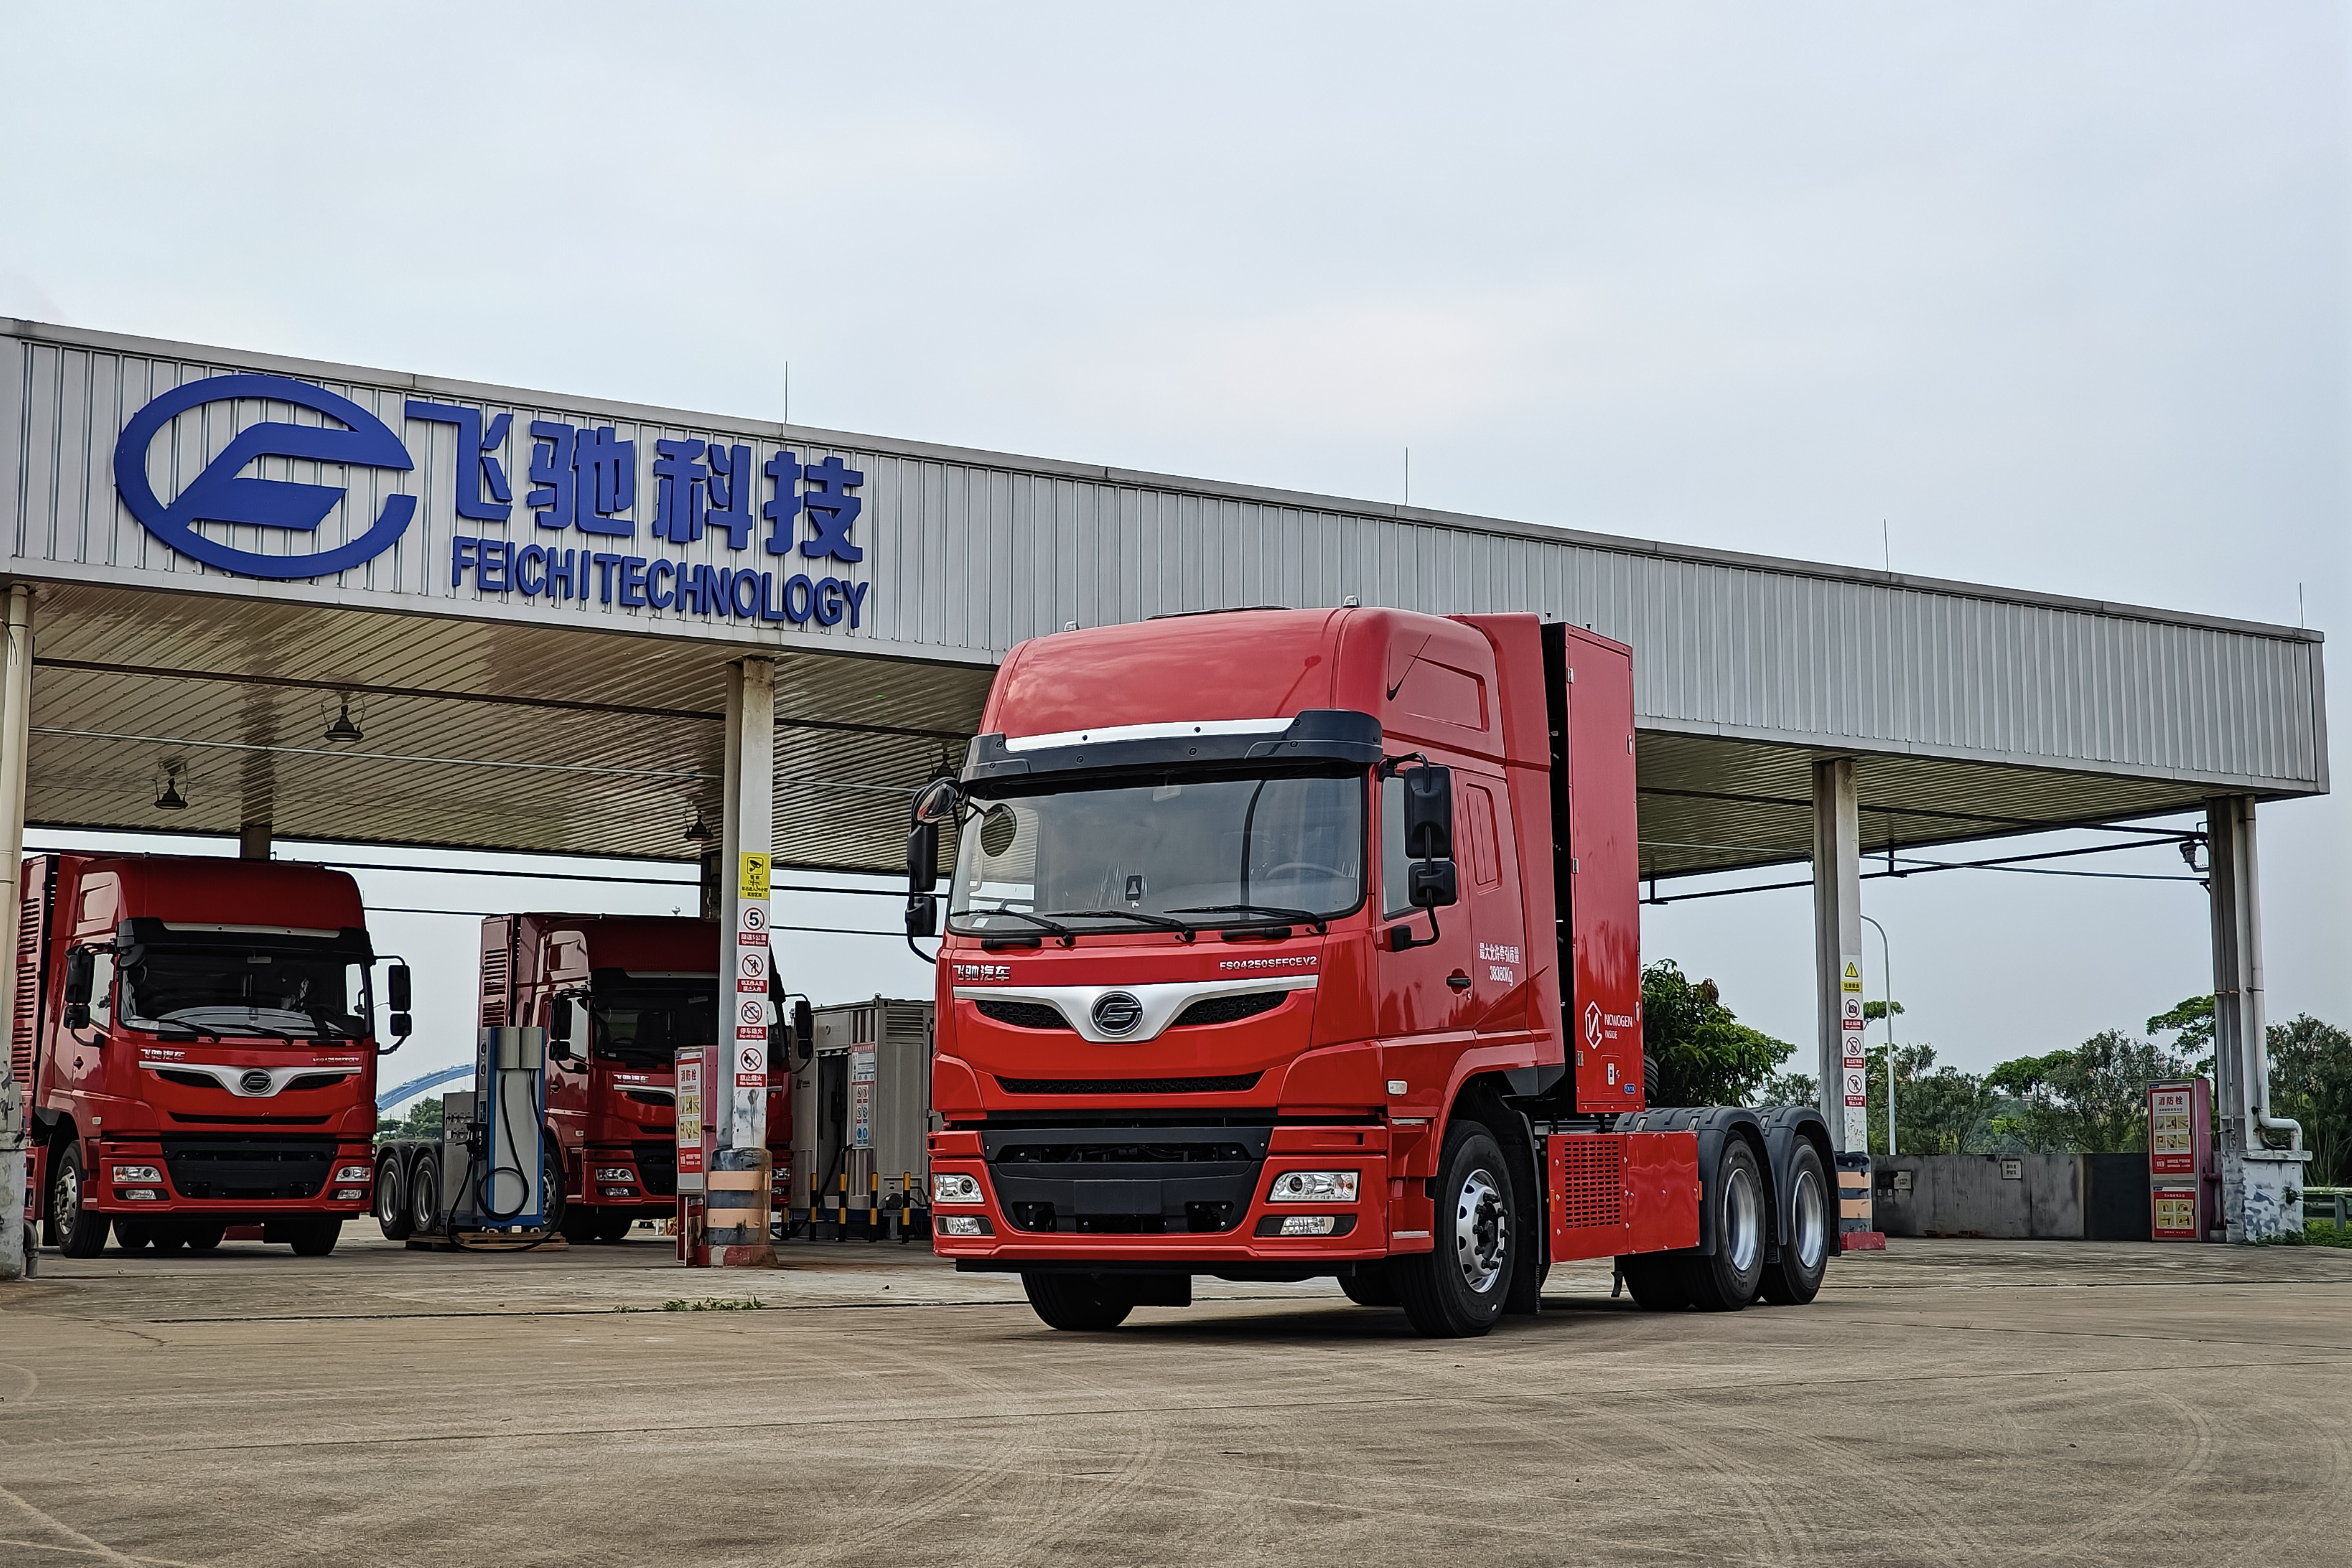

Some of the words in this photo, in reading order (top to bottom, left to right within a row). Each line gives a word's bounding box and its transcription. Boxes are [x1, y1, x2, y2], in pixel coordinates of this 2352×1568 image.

[405, 400, 863, 562] 飞驰科技
[749, 912, 759, 926] 5
[1479, 942, 1520, 964] 最大允许牵引质量
[1220, 956, 1317, 971] FSQ4250SFFCEV2
[953, 965, 1010, 981] 飞驰汽车
[1604, 1013, 1633, 1028] NOWOGEN
[141, 1049, 185, 1060] 飞驰汽车
[2158, 1096, 2183, 1105] 消防栓
